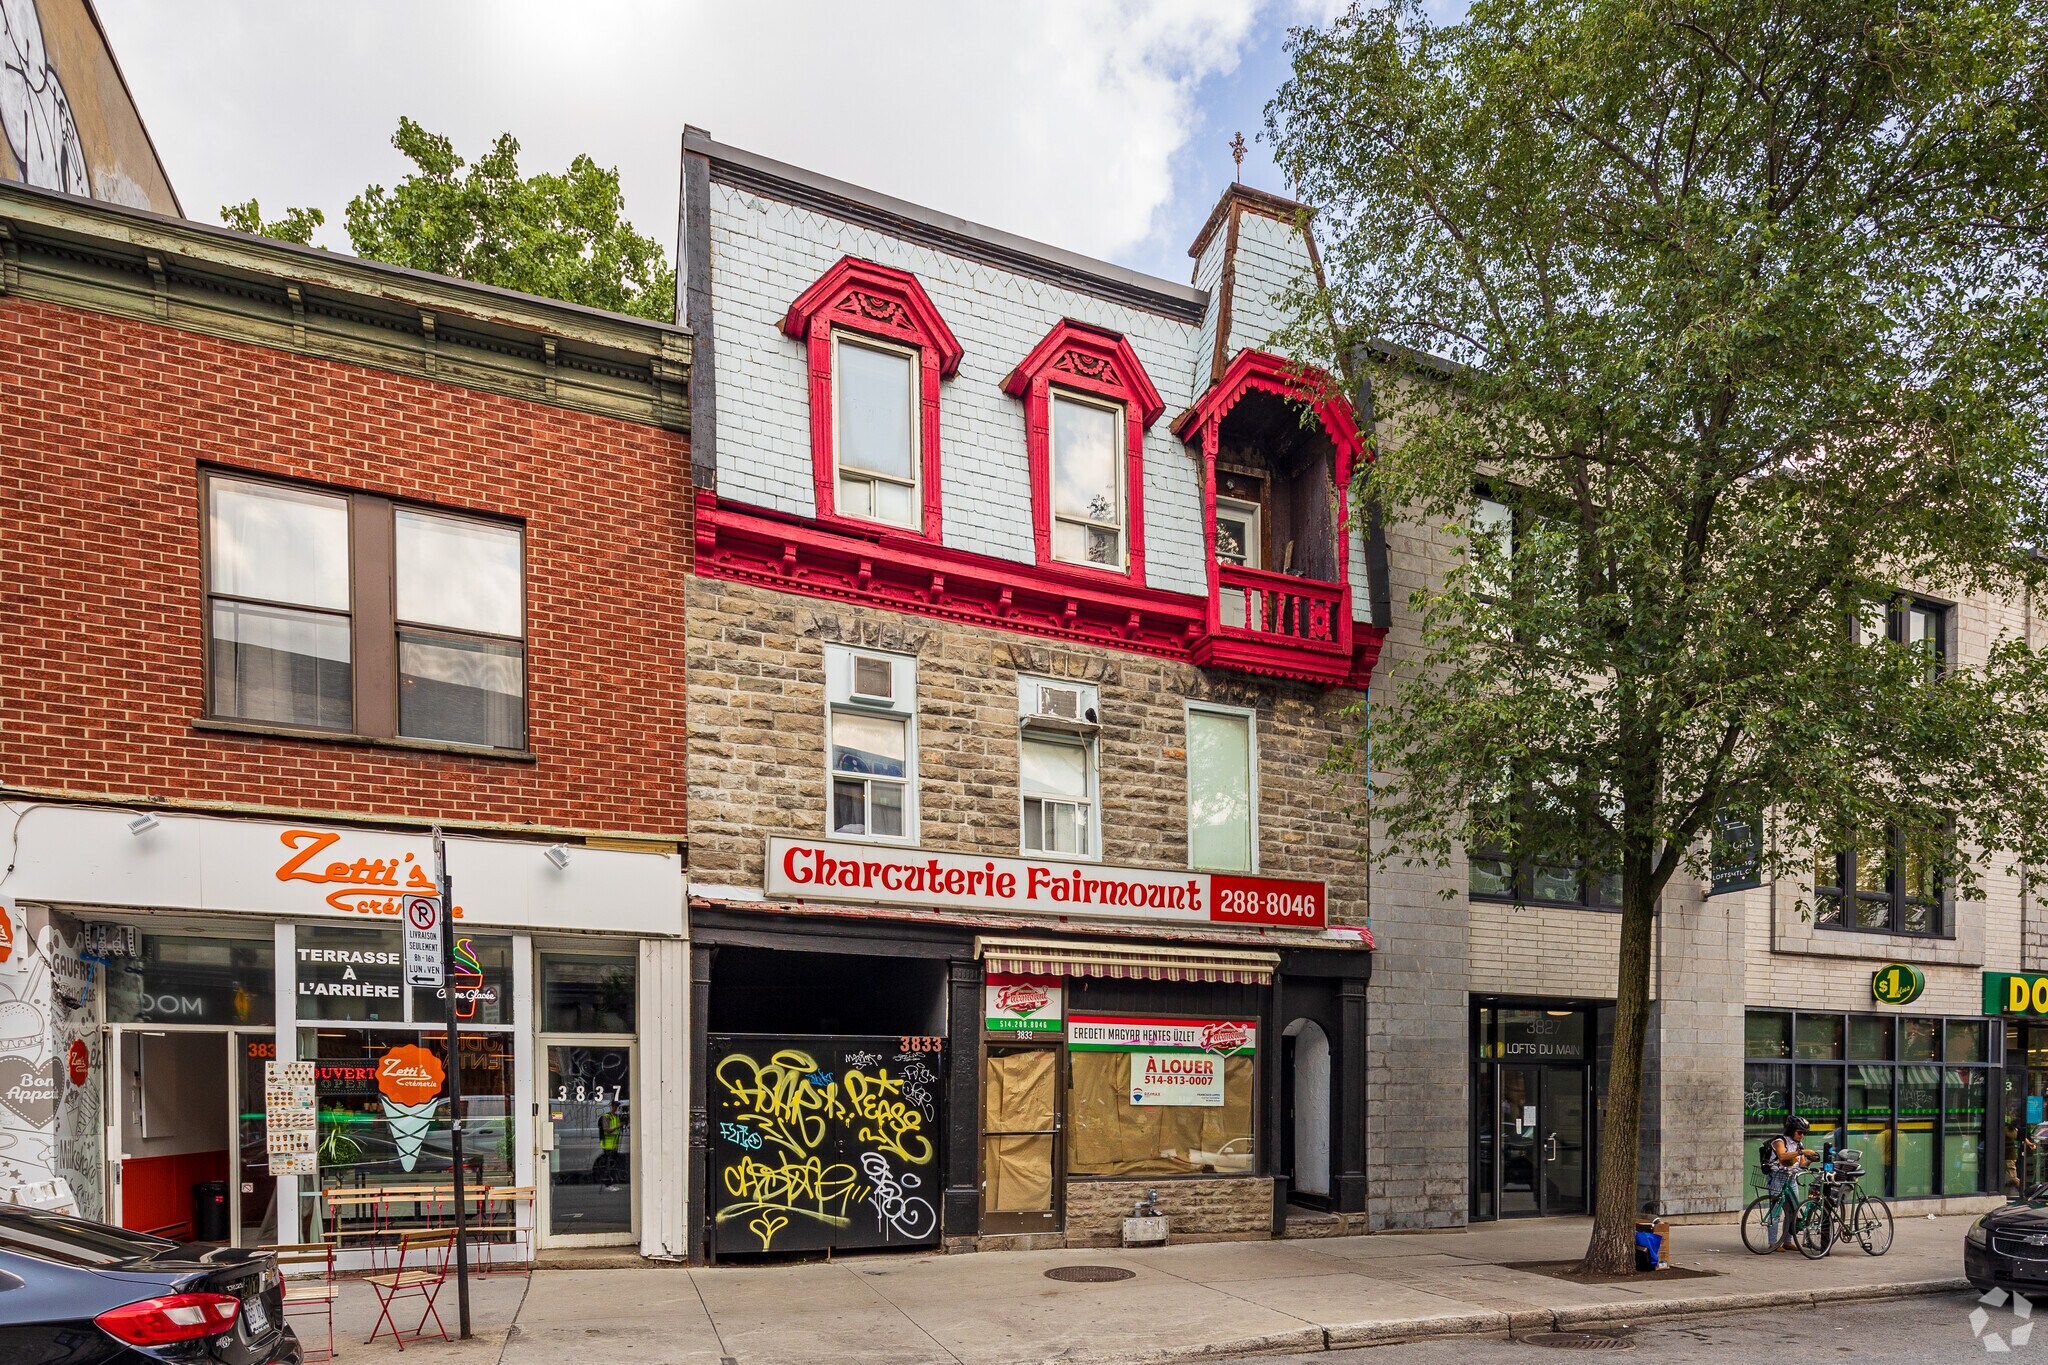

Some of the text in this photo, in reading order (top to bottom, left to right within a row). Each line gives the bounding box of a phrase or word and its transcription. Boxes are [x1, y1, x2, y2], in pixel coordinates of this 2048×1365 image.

[276, 829, 436, 890] Zetti's
[783, 846, 1201, 911] Charcuterie Fairmount
[1220, 889, 1315, 918] 288-8046
[409, 930, 437, 941] LIVRAISON
[409, 941, 438, 952] SEULEMENT
[297, 948, 400, 965] TERRASSE
[342, 965, 357, 980] À
[409, 964, 423, 973] LUN
[427, 966, 440, 974] VEN
[466, 989, 496, 1002] Glacée
[2009, 976, 2048, 1014] DO
[1000, 1020, 1047, 1029] 514.288.8046
[1526, 1019, 1561, 1035] 3827
[1016, 1030, 1033, 1040] 3833
[1074, 1027, 1195, 1043] EREDETI MAGYAR HENTES ÜZLET
[900, 1036, 942, 1052] 3833
[1506, 1043, 1580, 1055] LOFTS DU MAIN
[382, 1057, 432, 1078] Zetti's
[1146, 1056, 1214, 1075] À LOUER
[19, 1073, 55, 1087] Bon
[321, 1079, 368, 1089] OPEN
[1144, 1075, 1214, 1086] 514-813-0007
[557, 1085, 622, 1102] 3837
